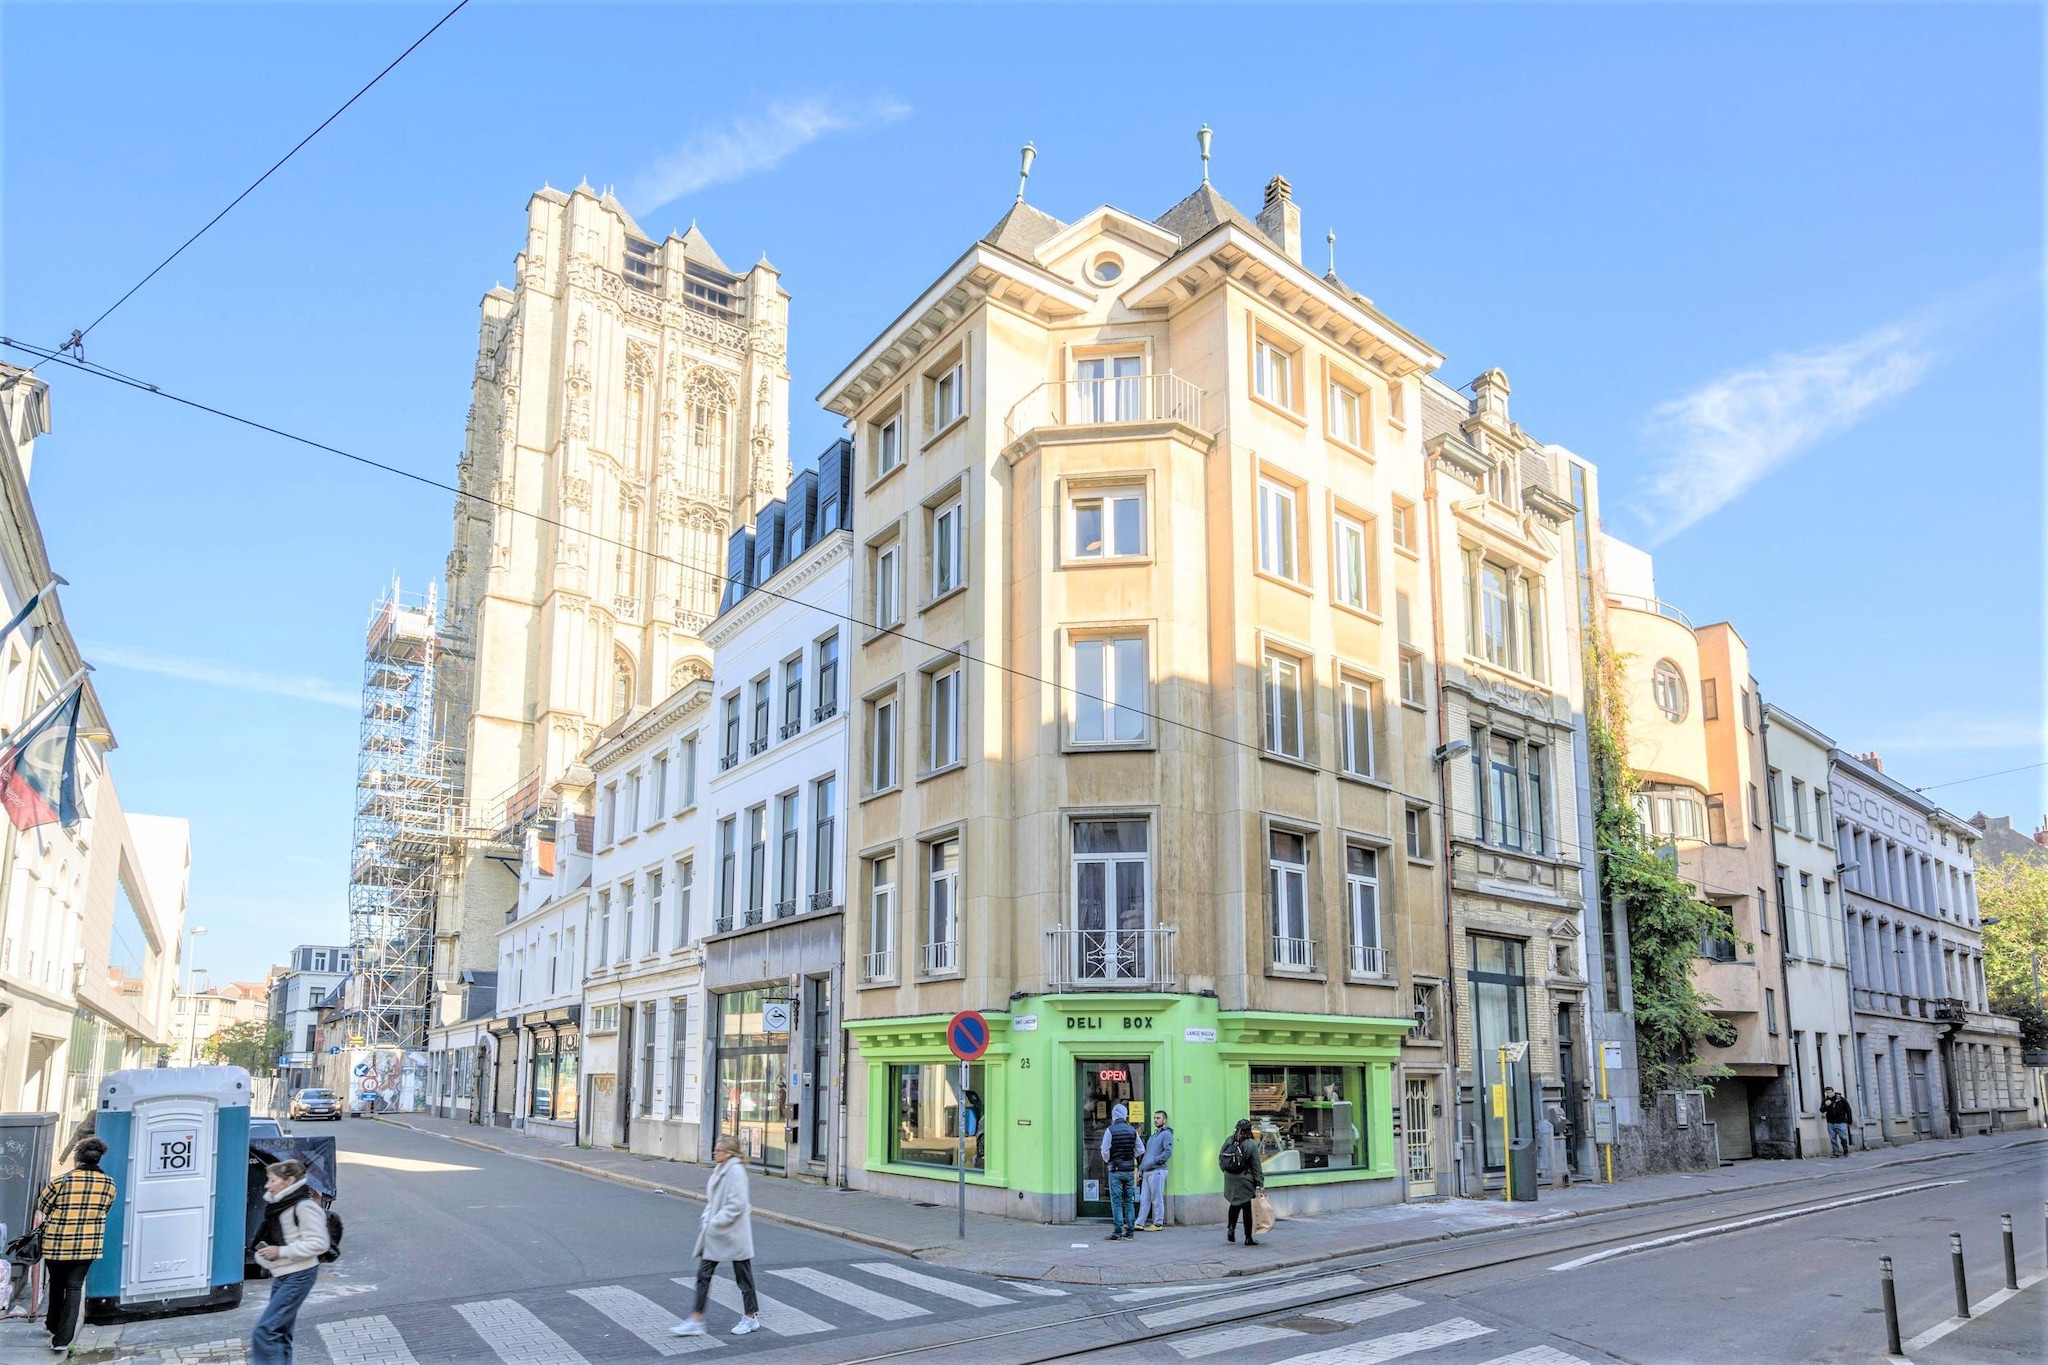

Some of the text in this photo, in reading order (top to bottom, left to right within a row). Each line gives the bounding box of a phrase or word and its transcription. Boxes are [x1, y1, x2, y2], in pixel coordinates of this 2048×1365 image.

[1067, 1017, 1153, 1029] DELI BOX
[1020, 1057, 1031, 1069] 23
[1100, 1070, 1127, 1081] OPEN
[161, 1139, 192, 1155] TOI
[160, 1155, 191, 1169] TOI
